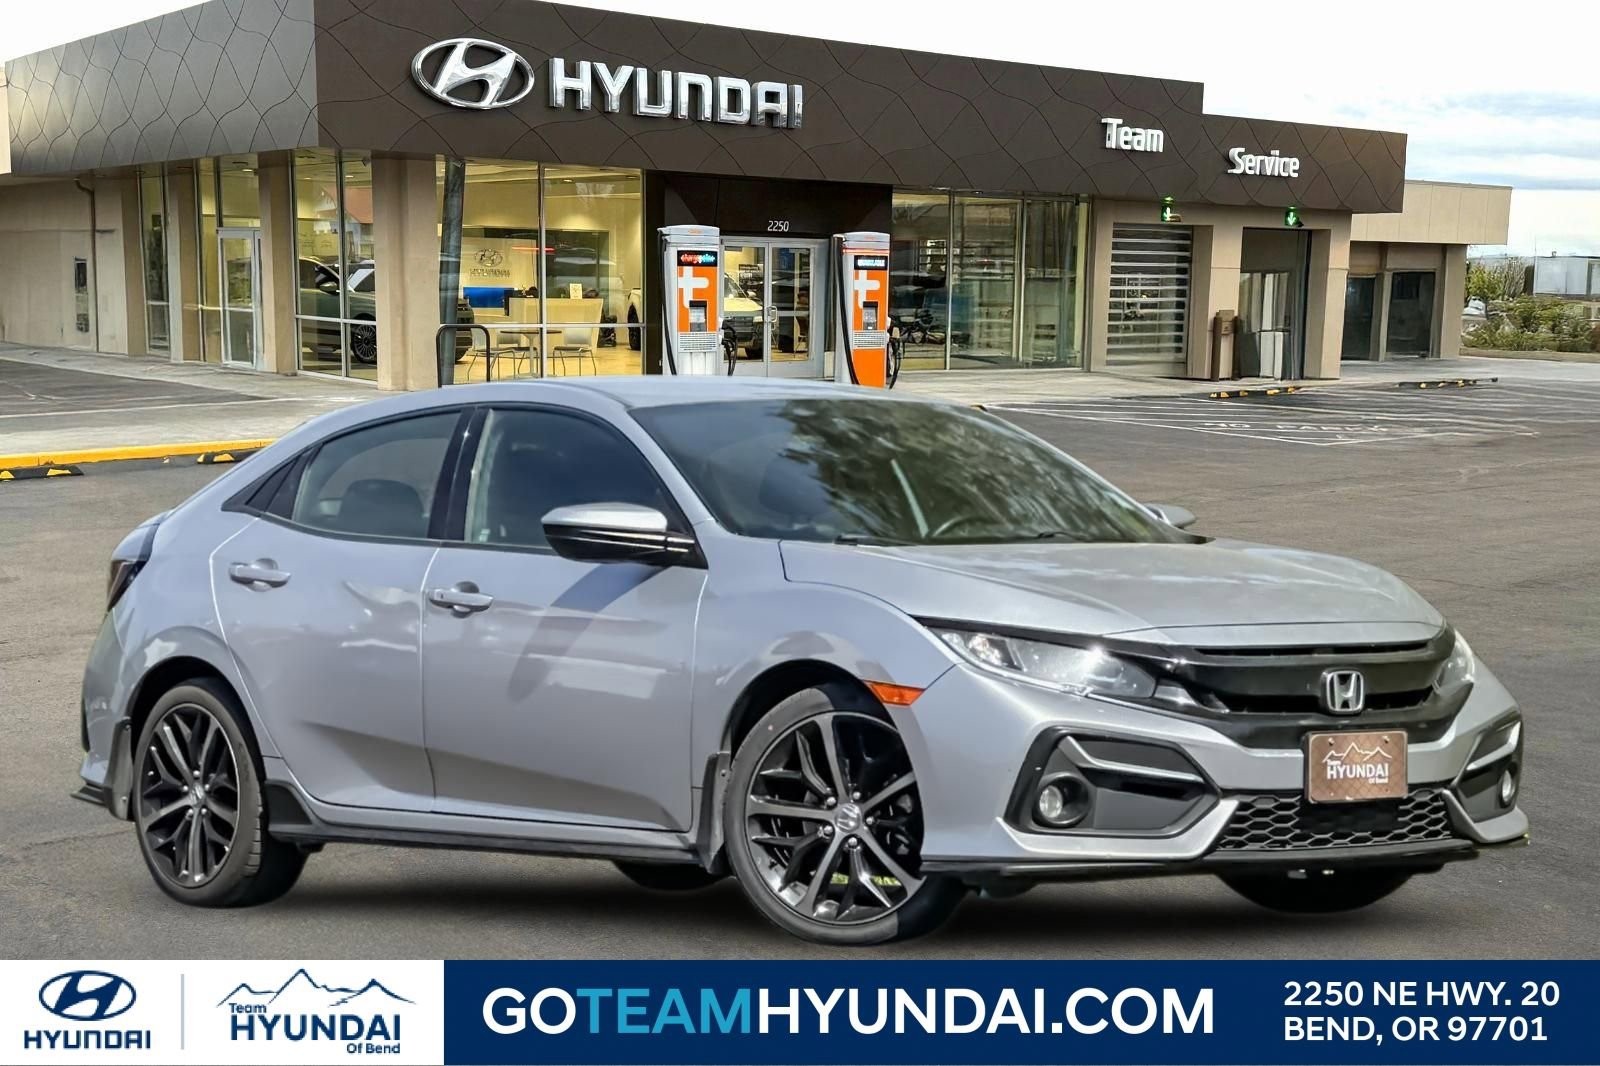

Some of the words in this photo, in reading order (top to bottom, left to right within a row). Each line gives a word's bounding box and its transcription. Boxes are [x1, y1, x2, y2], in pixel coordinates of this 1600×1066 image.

[548, 57, 803, 129] HYUNDAI
[1101, 117, 1164, 153] Team
[1227, 147, 1300, 178] Service
[767, 220, 790, 232] 2250
[1327, 763, 1389, 780] HYUNDAI
